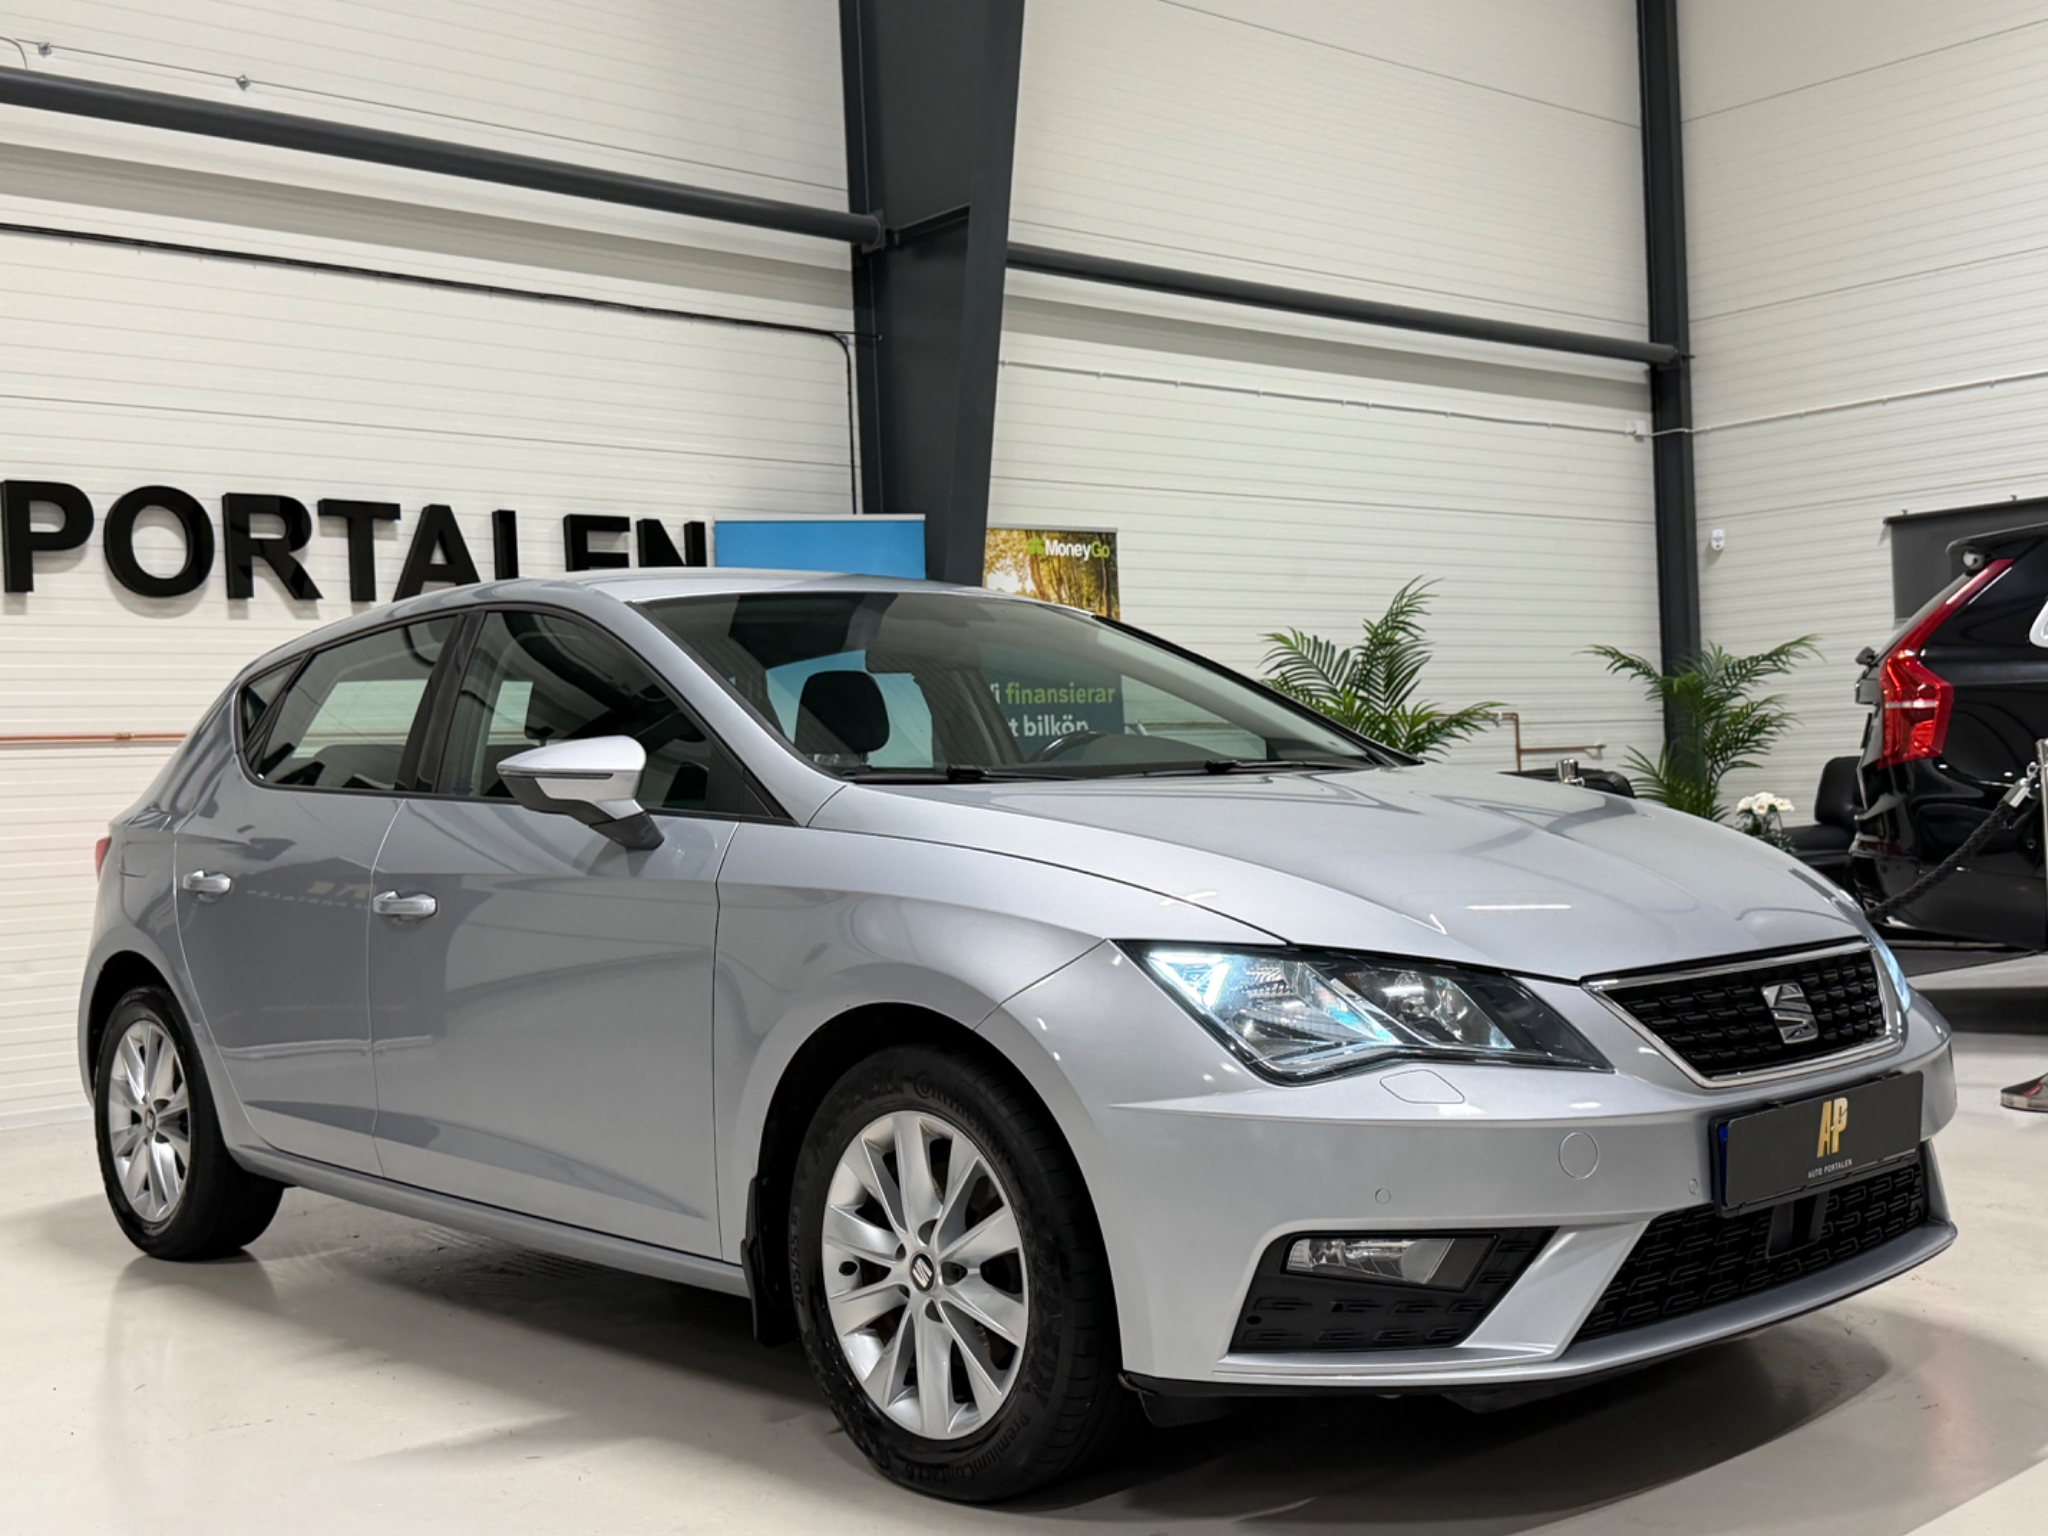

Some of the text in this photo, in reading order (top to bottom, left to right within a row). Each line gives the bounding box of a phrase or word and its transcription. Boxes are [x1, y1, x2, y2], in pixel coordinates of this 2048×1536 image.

[3, 480, 707, 603] PORTALEN
[1045, 539, 1110, 561] MoneyGo
[1005, 682, 1116, 705] finansierar
[1817, 1097, 1848, 1159] AP
